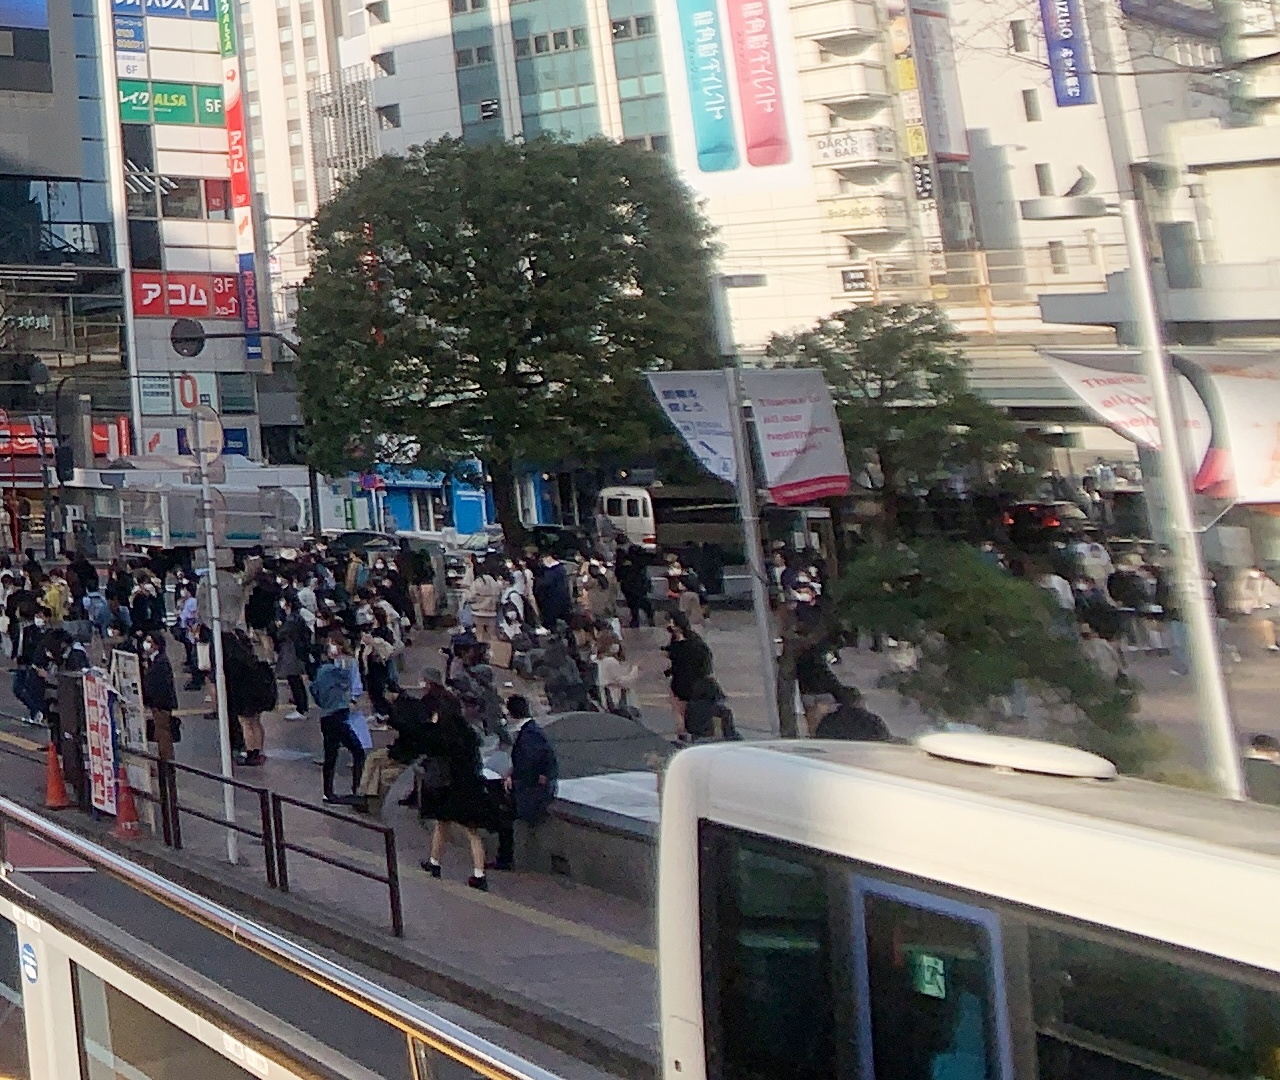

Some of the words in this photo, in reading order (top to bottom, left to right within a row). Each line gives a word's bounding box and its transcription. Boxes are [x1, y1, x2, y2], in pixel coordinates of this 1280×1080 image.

[126, 65, 138, 74] 6F
[120, 91, 149, 104] レイク
[154, 94, 187, 107] ALSA
[205, 99, 222, 112] 5F
[229, 131, 244, 173] アコム
[834, 147, 859, 157] BAR
[141, 283, 208, 306] アコム
[214, 278, 235, 294] 3F
